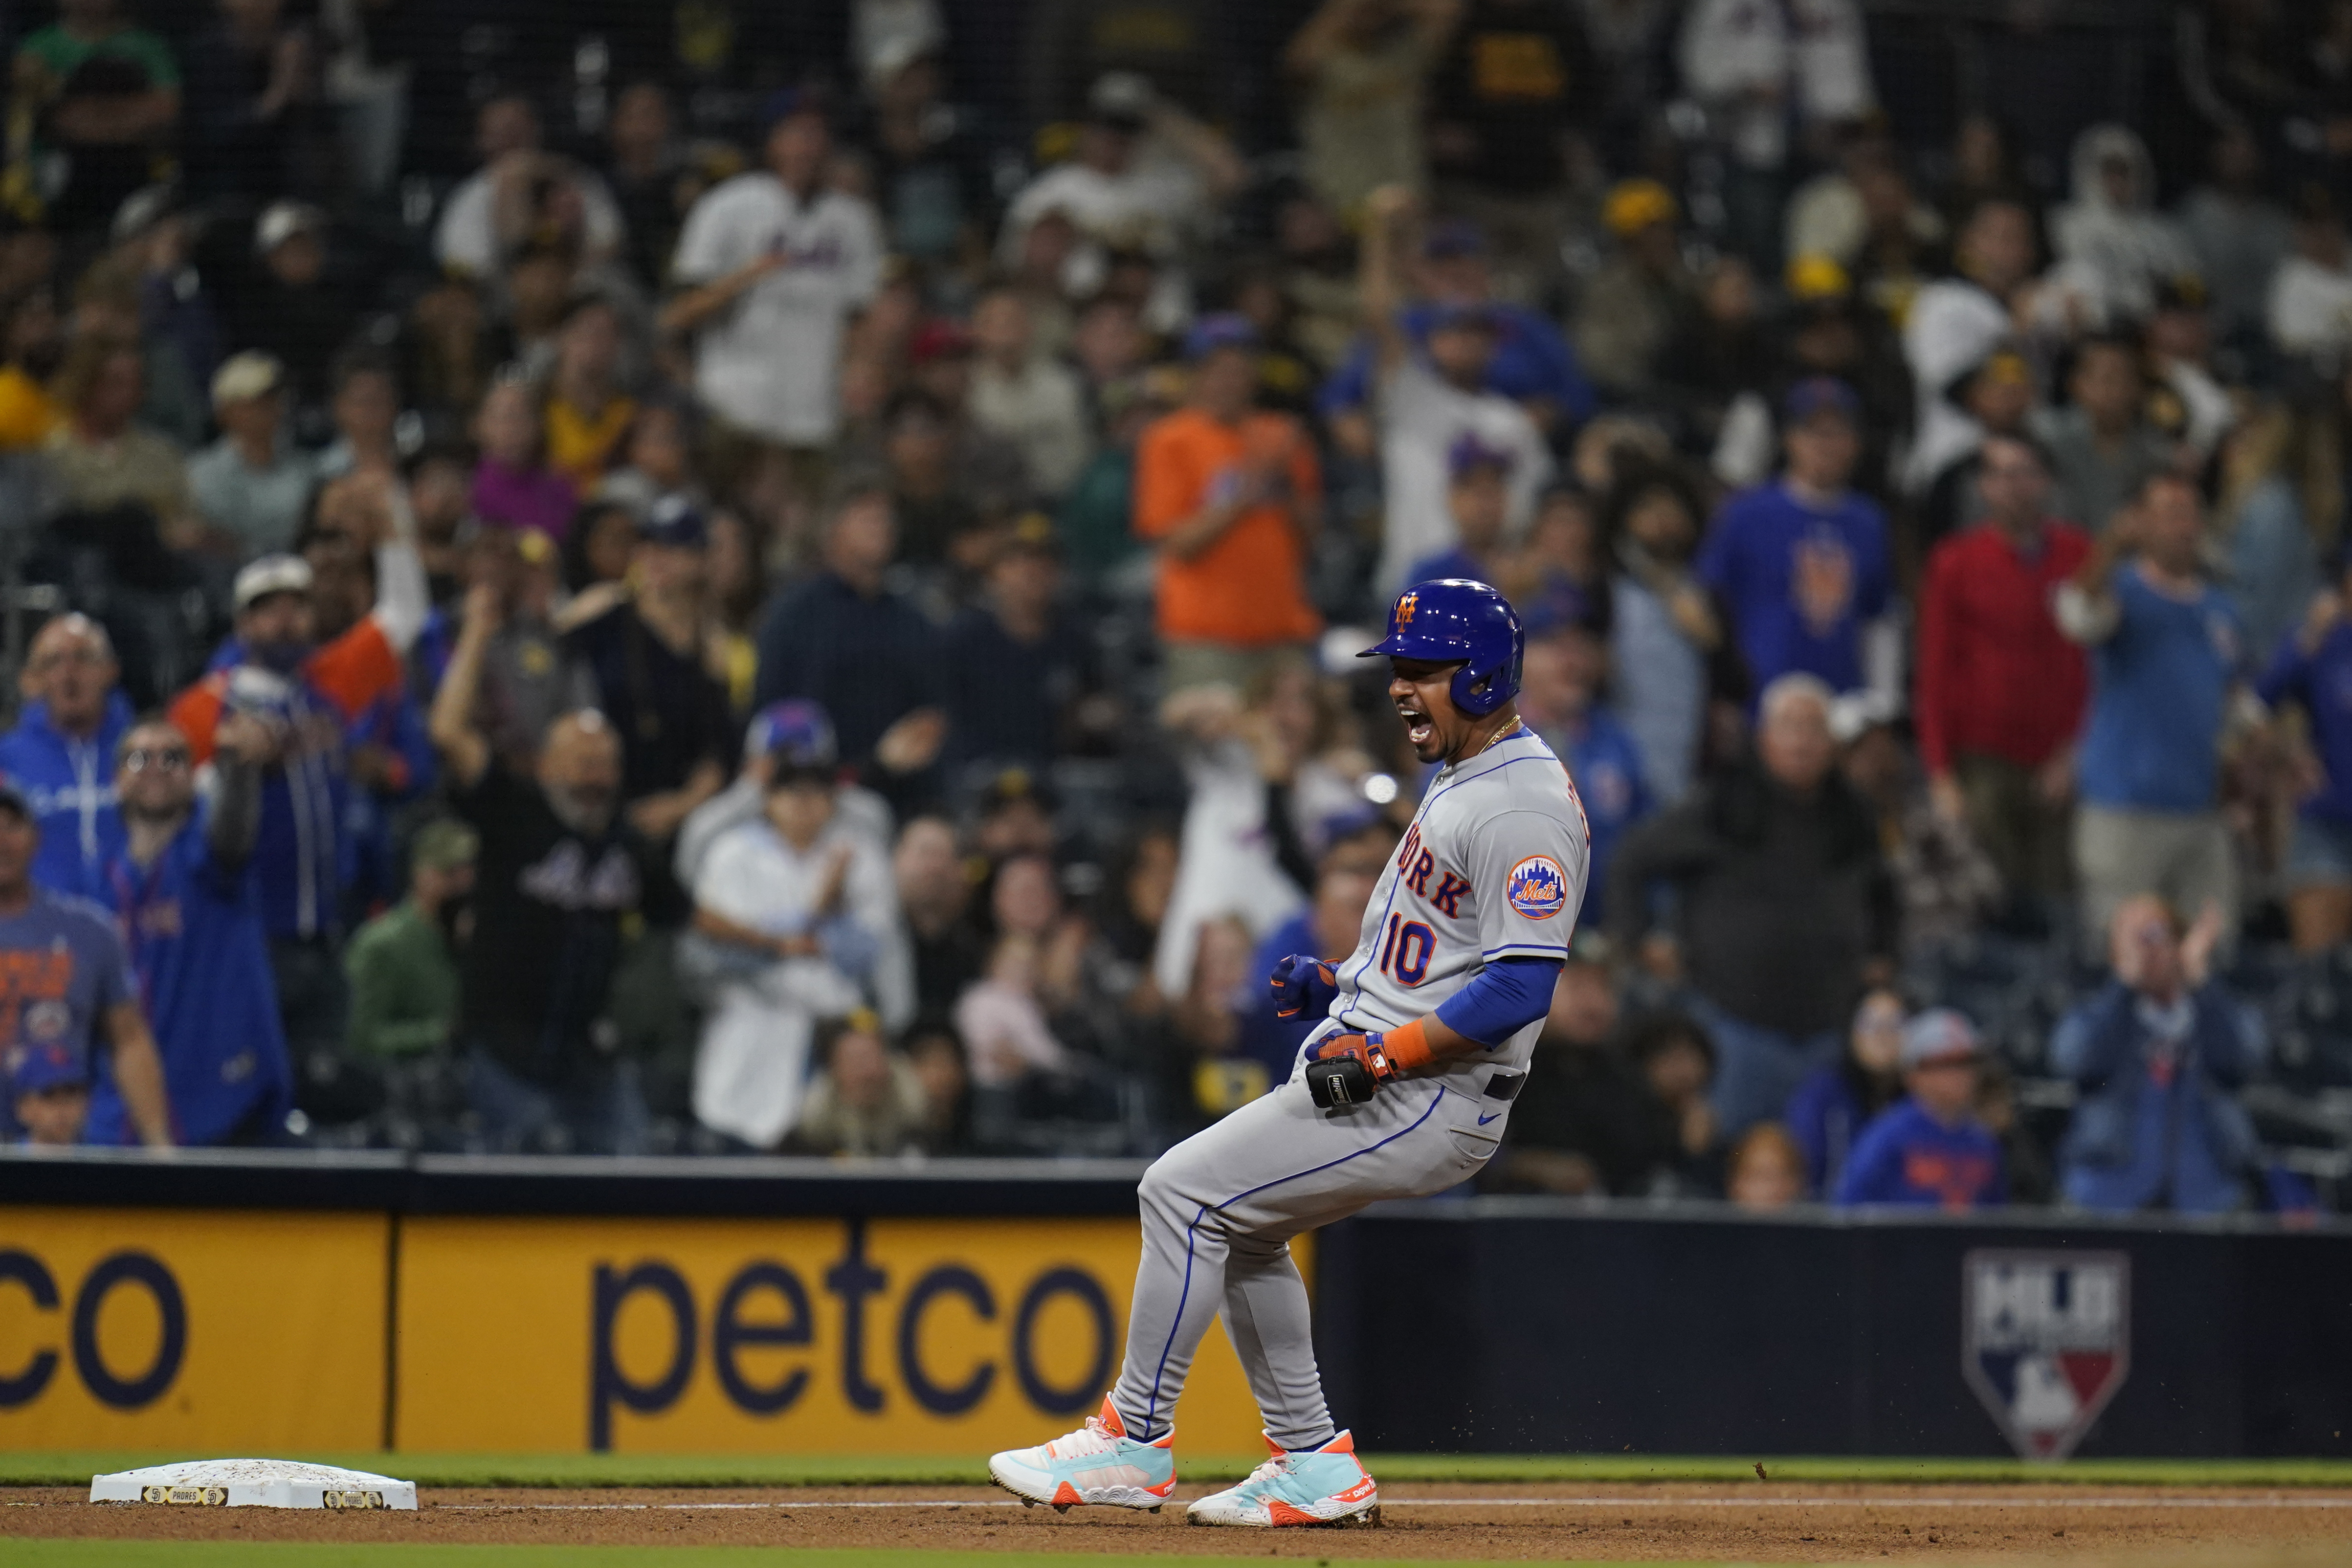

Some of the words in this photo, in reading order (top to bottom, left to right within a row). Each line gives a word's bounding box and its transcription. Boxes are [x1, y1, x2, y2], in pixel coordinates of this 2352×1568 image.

[1516, 880, 1557, 901] Mets
[1380, 911, 1437, 986] 10
[590, 1216, 1118, 1454] petco
[173, 1491, 197, 1500] PADRES
[1352, 1483, 1371, 1498] new
